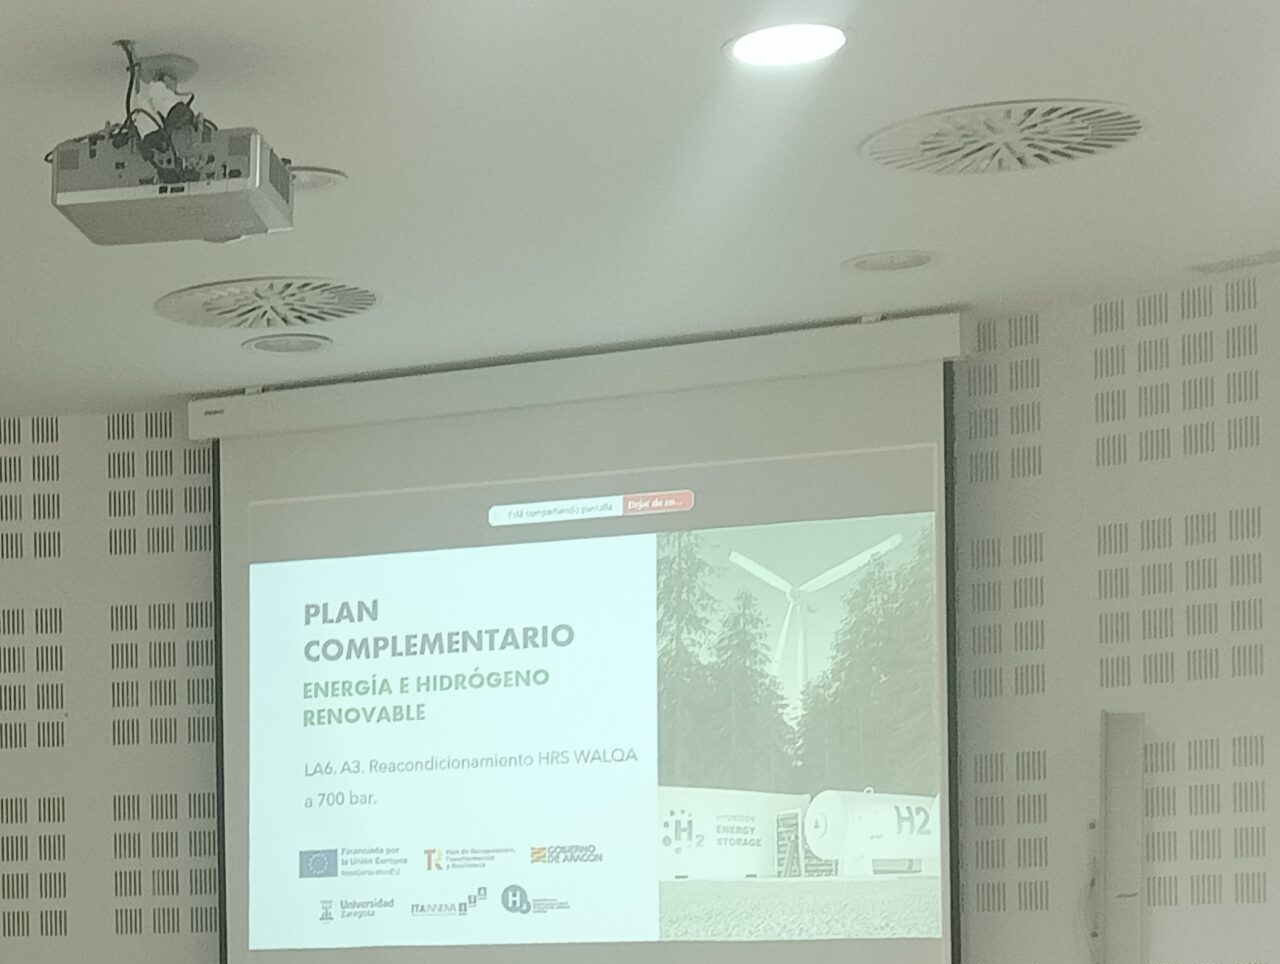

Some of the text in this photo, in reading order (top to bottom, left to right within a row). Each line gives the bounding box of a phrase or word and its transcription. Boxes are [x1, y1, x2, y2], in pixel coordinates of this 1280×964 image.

[304, 599, 378, 626] PLAN
[303, 624, 575, 662] COMPLEMENTARIO
[303, 667, 550, 699] ENERGÍA E HIDRÓGENO
[303, 703, 426, 727] RENOVABLE
[369, 753, 534, 774] Reacondicionamiento
[539, 750, 570, 766] HRS
[573, 747, 638, 764] WALQA
[304, 790, 378, 808] a 700 bar.
[716, 825, 755, 835] ENERGY
[894, 805, 932, 836] H2
[716, 837, 762, 847] STORAGE
[340, 898, 395, 909] Universidad
